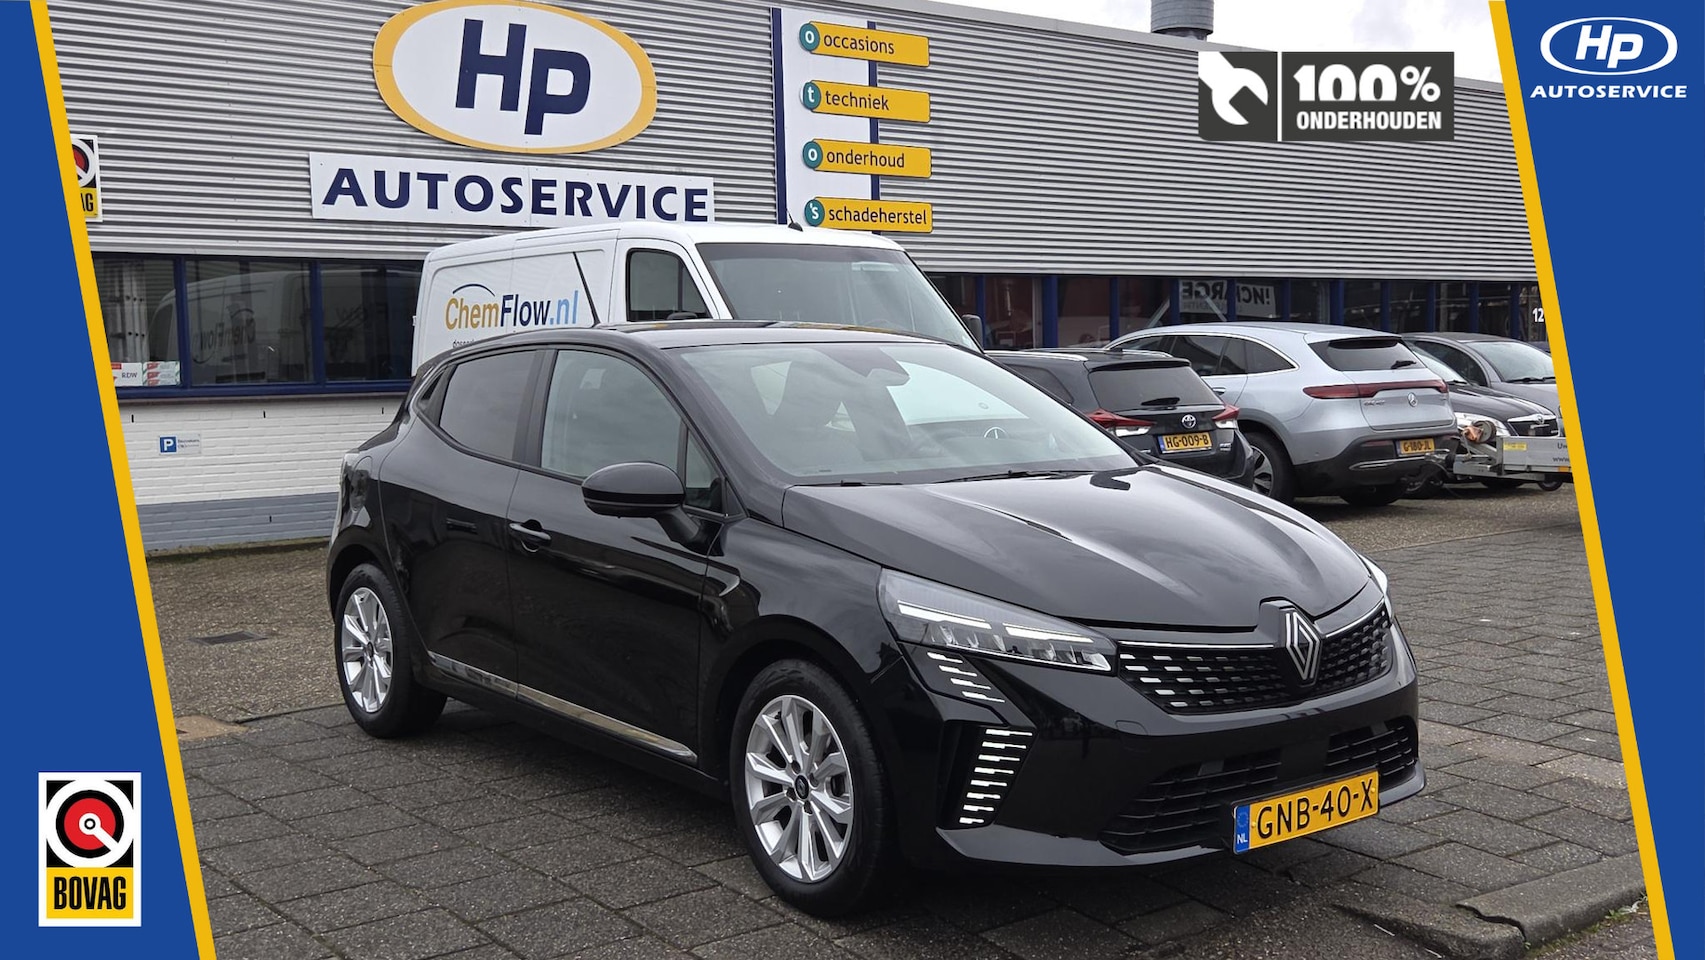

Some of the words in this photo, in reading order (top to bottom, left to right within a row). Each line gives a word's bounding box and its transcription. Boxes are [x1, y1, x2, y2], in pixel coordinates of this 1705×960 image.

[804, 31, 815, 44] o
[823, 34, 895, 55] occasions
[807, 86, 815, 103] t
[825, 90, 890, 111] techniek
[807, 149, 818, 161] o
[826, 149, 905, 168] onderhoud
[322, 167, 709, 222] AUTOSERVICE
[828, 205, 927, 225] schadeherstel
[445, 290, 579, 330] ChemFlow.nl
[1532, 307, 1545, 323] 12
[1165, 434, 1209, 448] HG-009-B
[1257, 778, 1373, 839] GNB-40-X
[1236, 832, 1248, 844] NL
